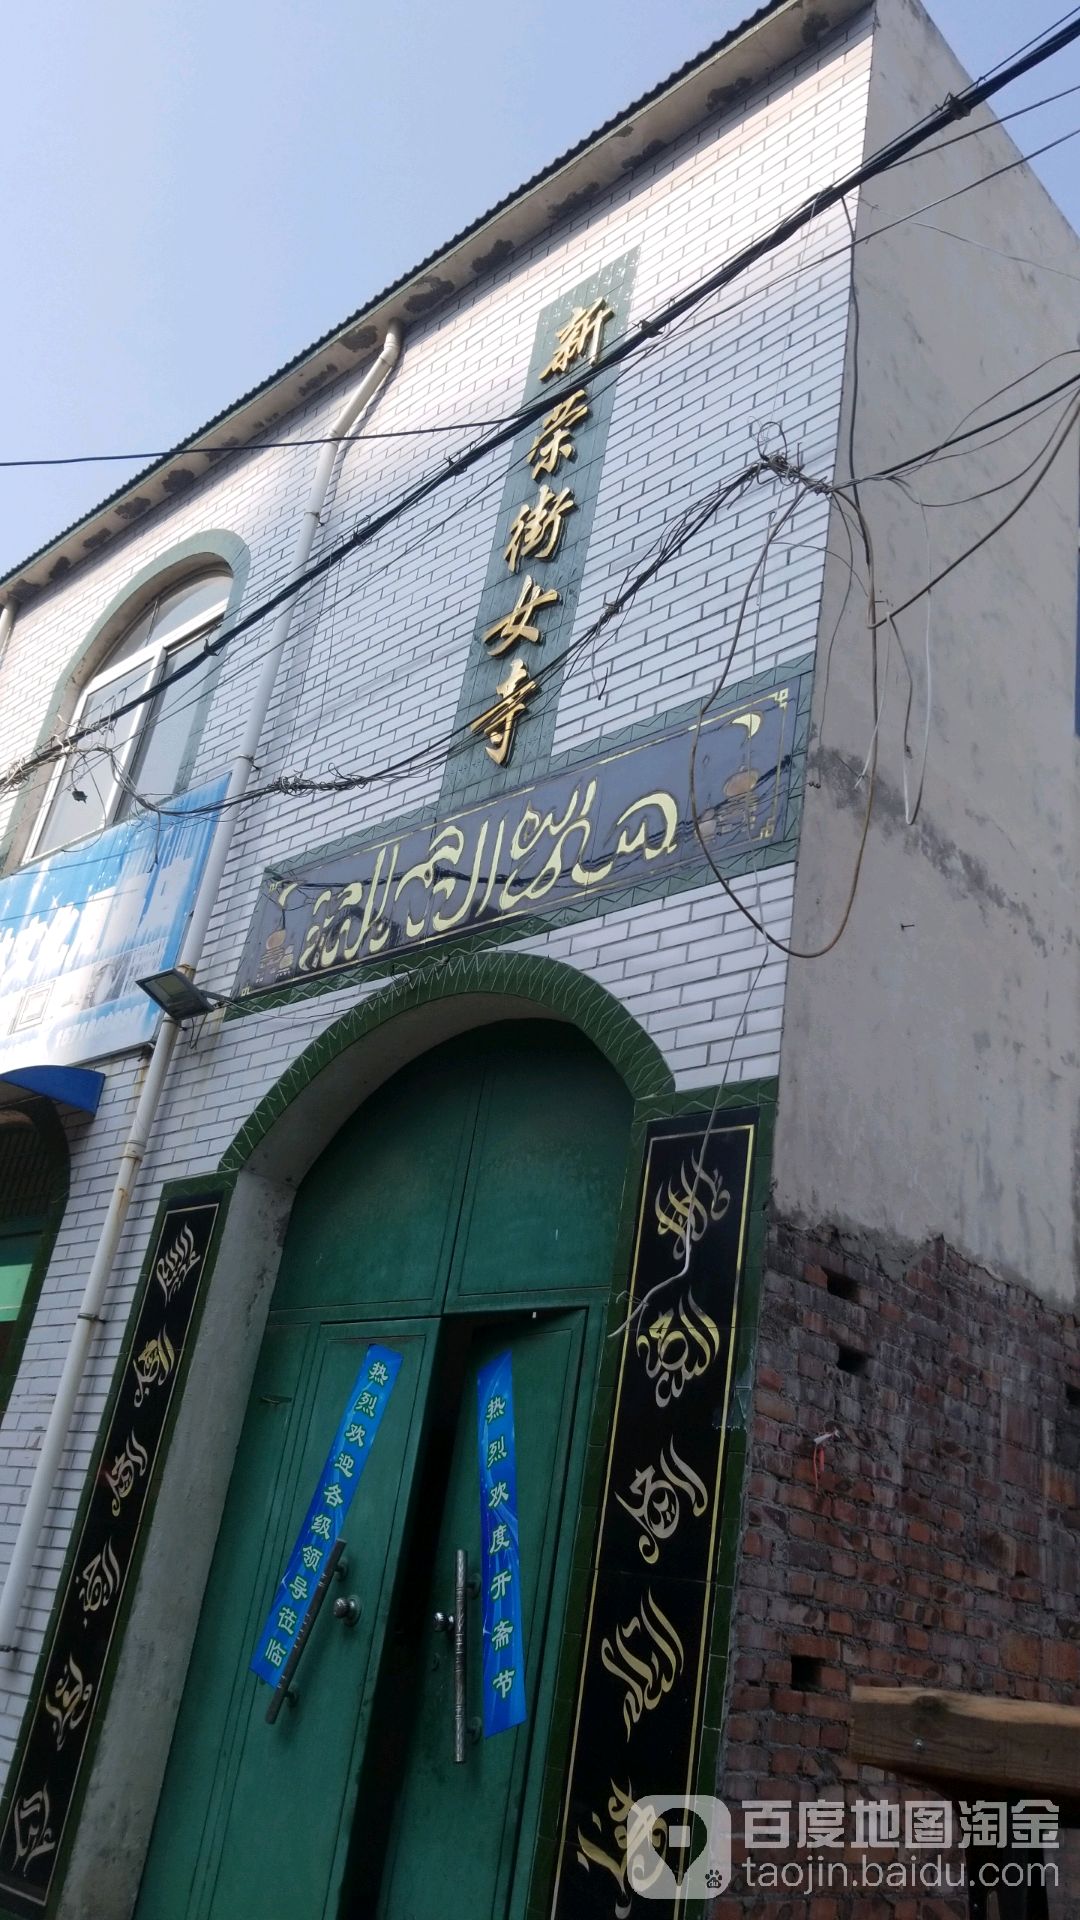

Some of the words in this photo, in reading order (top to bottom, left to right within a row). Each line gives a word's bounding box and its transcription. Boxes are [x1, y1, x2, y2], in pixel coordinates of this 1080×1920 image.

[470, 296, 614, 768] 新荣街女寺
[265, 1361, 390, 1667] 热烈欢迎各级领导莅临
[485, 1396, 517, 1699] 热烈欢度开斋节
